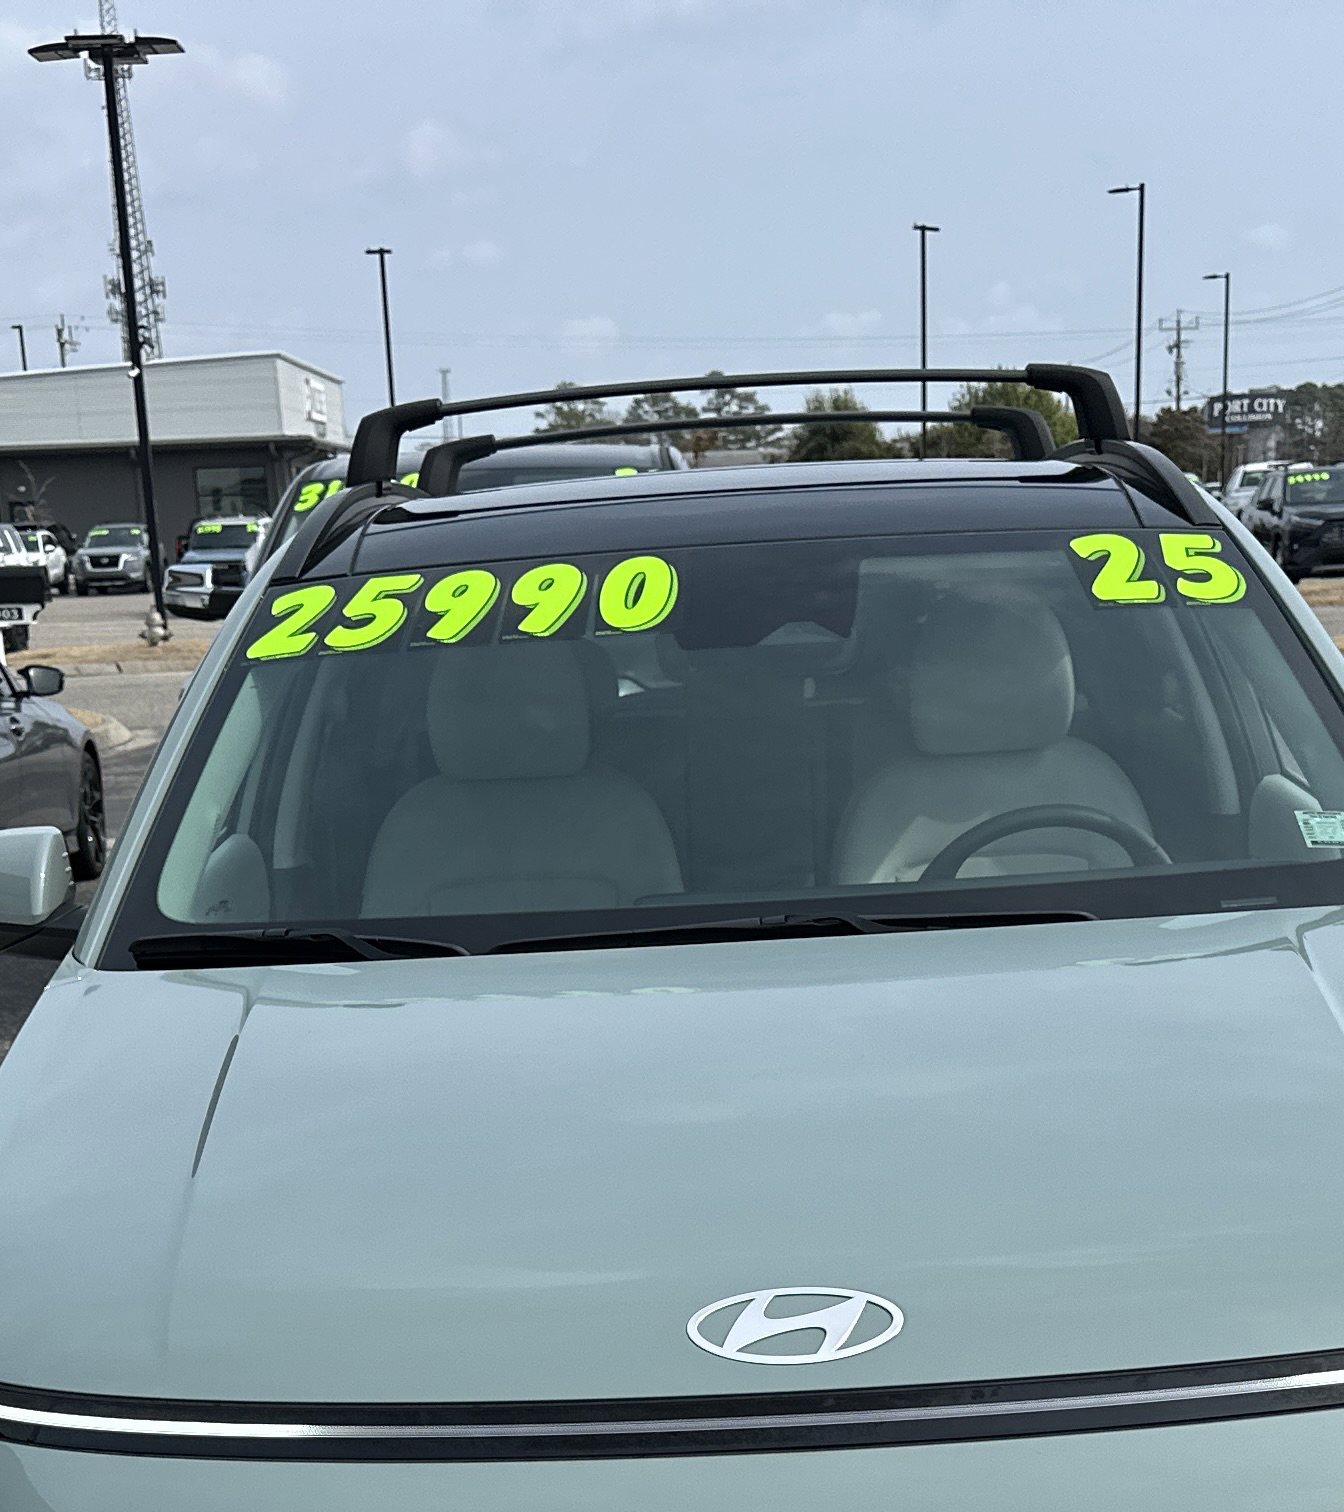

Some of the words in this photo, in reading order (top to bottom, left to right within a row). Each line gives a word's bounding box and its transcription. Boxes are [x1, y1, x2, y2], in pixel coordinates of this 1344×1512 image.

[1254, 397, 1287, 413] CITY
[246, 556, 678, 660] 25990
[1069, 534, 1248, 604] 25
